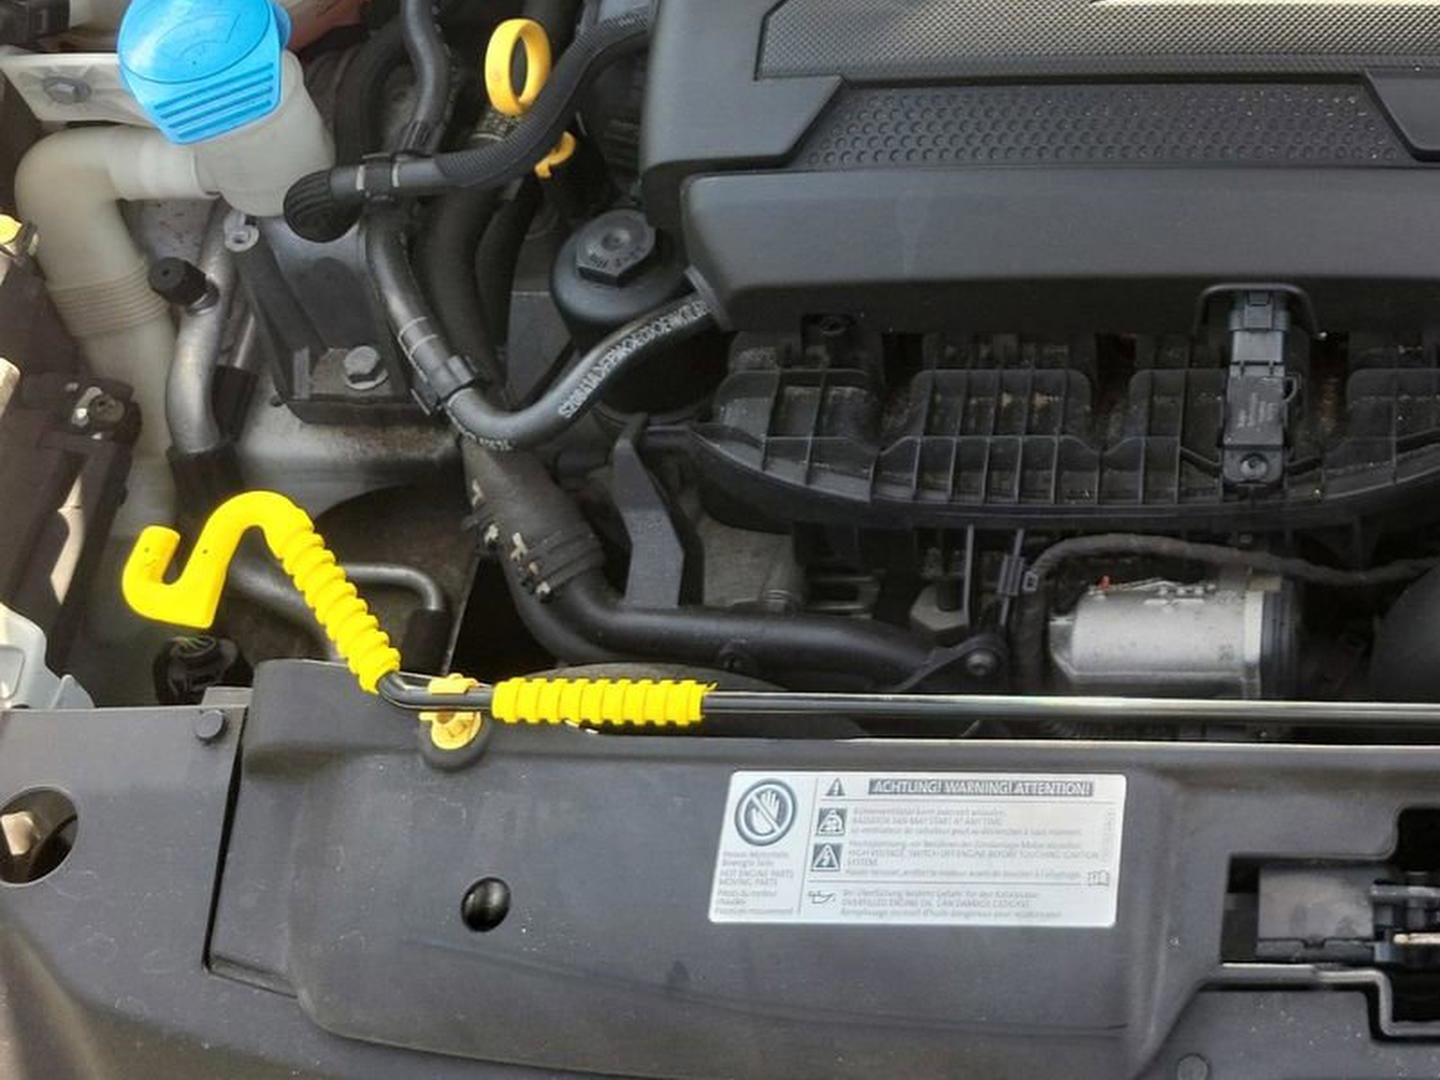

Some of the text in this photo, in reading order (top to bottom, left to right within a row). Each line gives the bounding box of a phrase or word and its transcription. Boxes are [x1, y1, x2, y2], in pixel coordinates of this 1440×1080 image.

[872, 779, 1091, 795] ACHTUNG! WARNING! ATTENTION!
